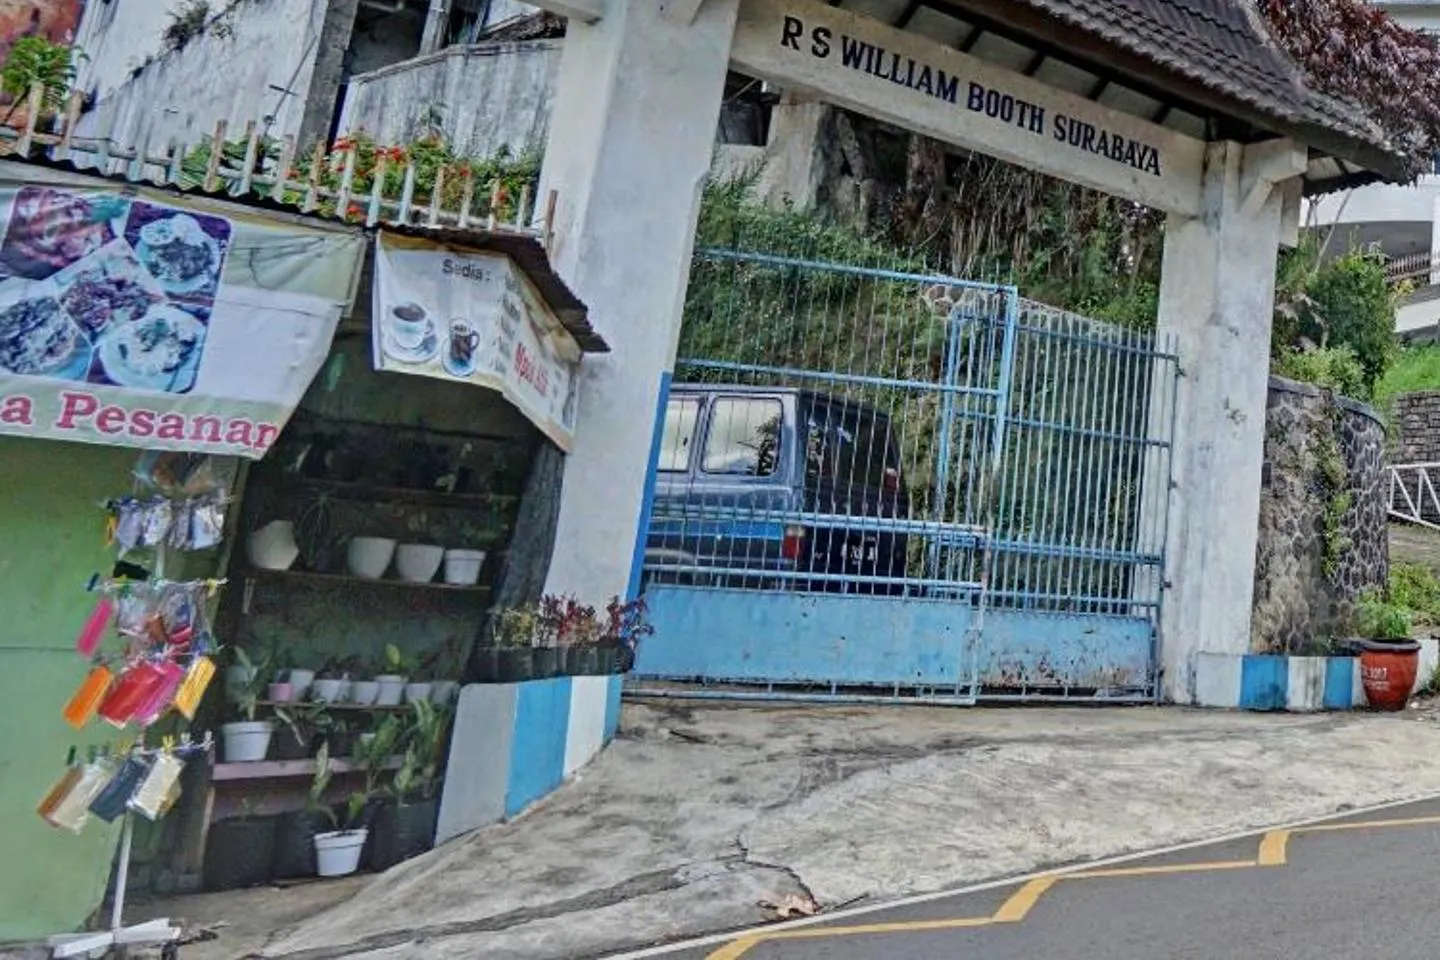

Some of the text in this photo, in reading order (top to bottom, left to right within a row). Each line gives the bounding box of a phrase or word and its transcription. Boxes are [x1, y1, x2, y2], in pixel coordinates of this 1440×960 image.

[841, 34, 959, 104] WILLIAM
[967, 81, 1046, 135] BOOTH
[1053, 114, 1161, 177] SURABAYA
